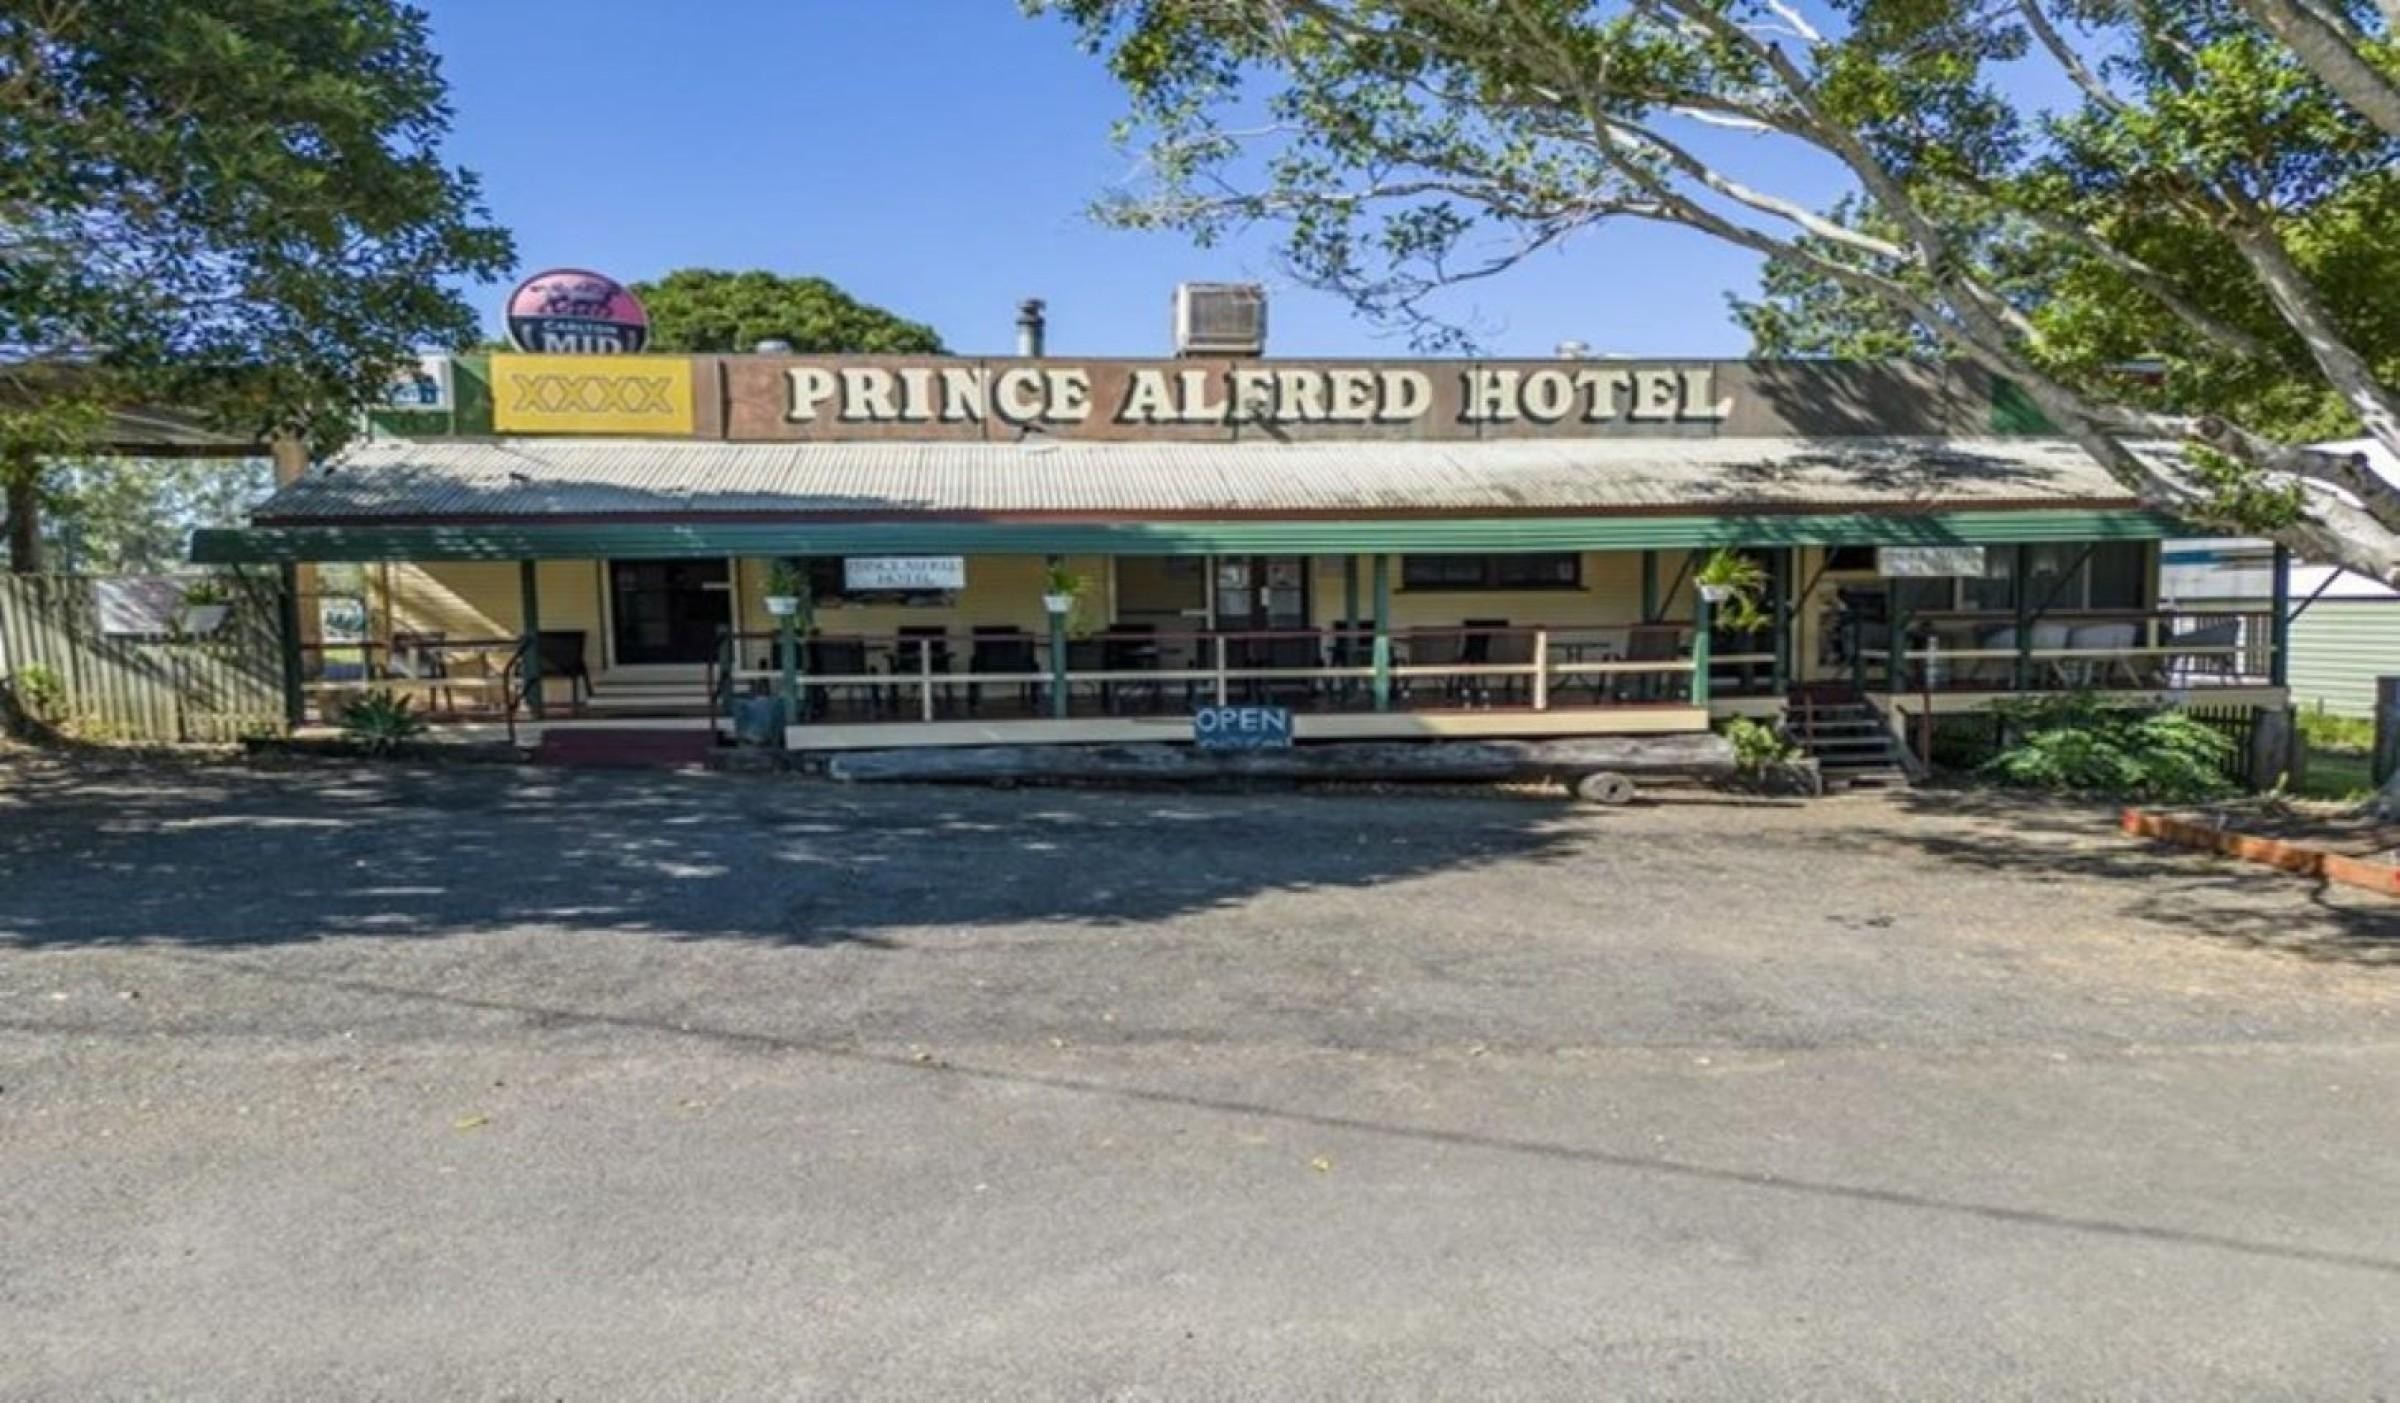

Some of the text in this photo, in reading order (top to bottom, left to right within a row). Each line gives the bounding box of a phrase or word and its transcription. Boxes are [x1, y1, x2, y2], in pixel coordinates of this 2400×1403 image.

[543, 332, 623, 354] MID
[511, 373, 674, 413] XXXX
[785, 366, 1734, 424] PRINCE ALFRED HOTEL
[1196, 706, 1287, 732] OPEN
